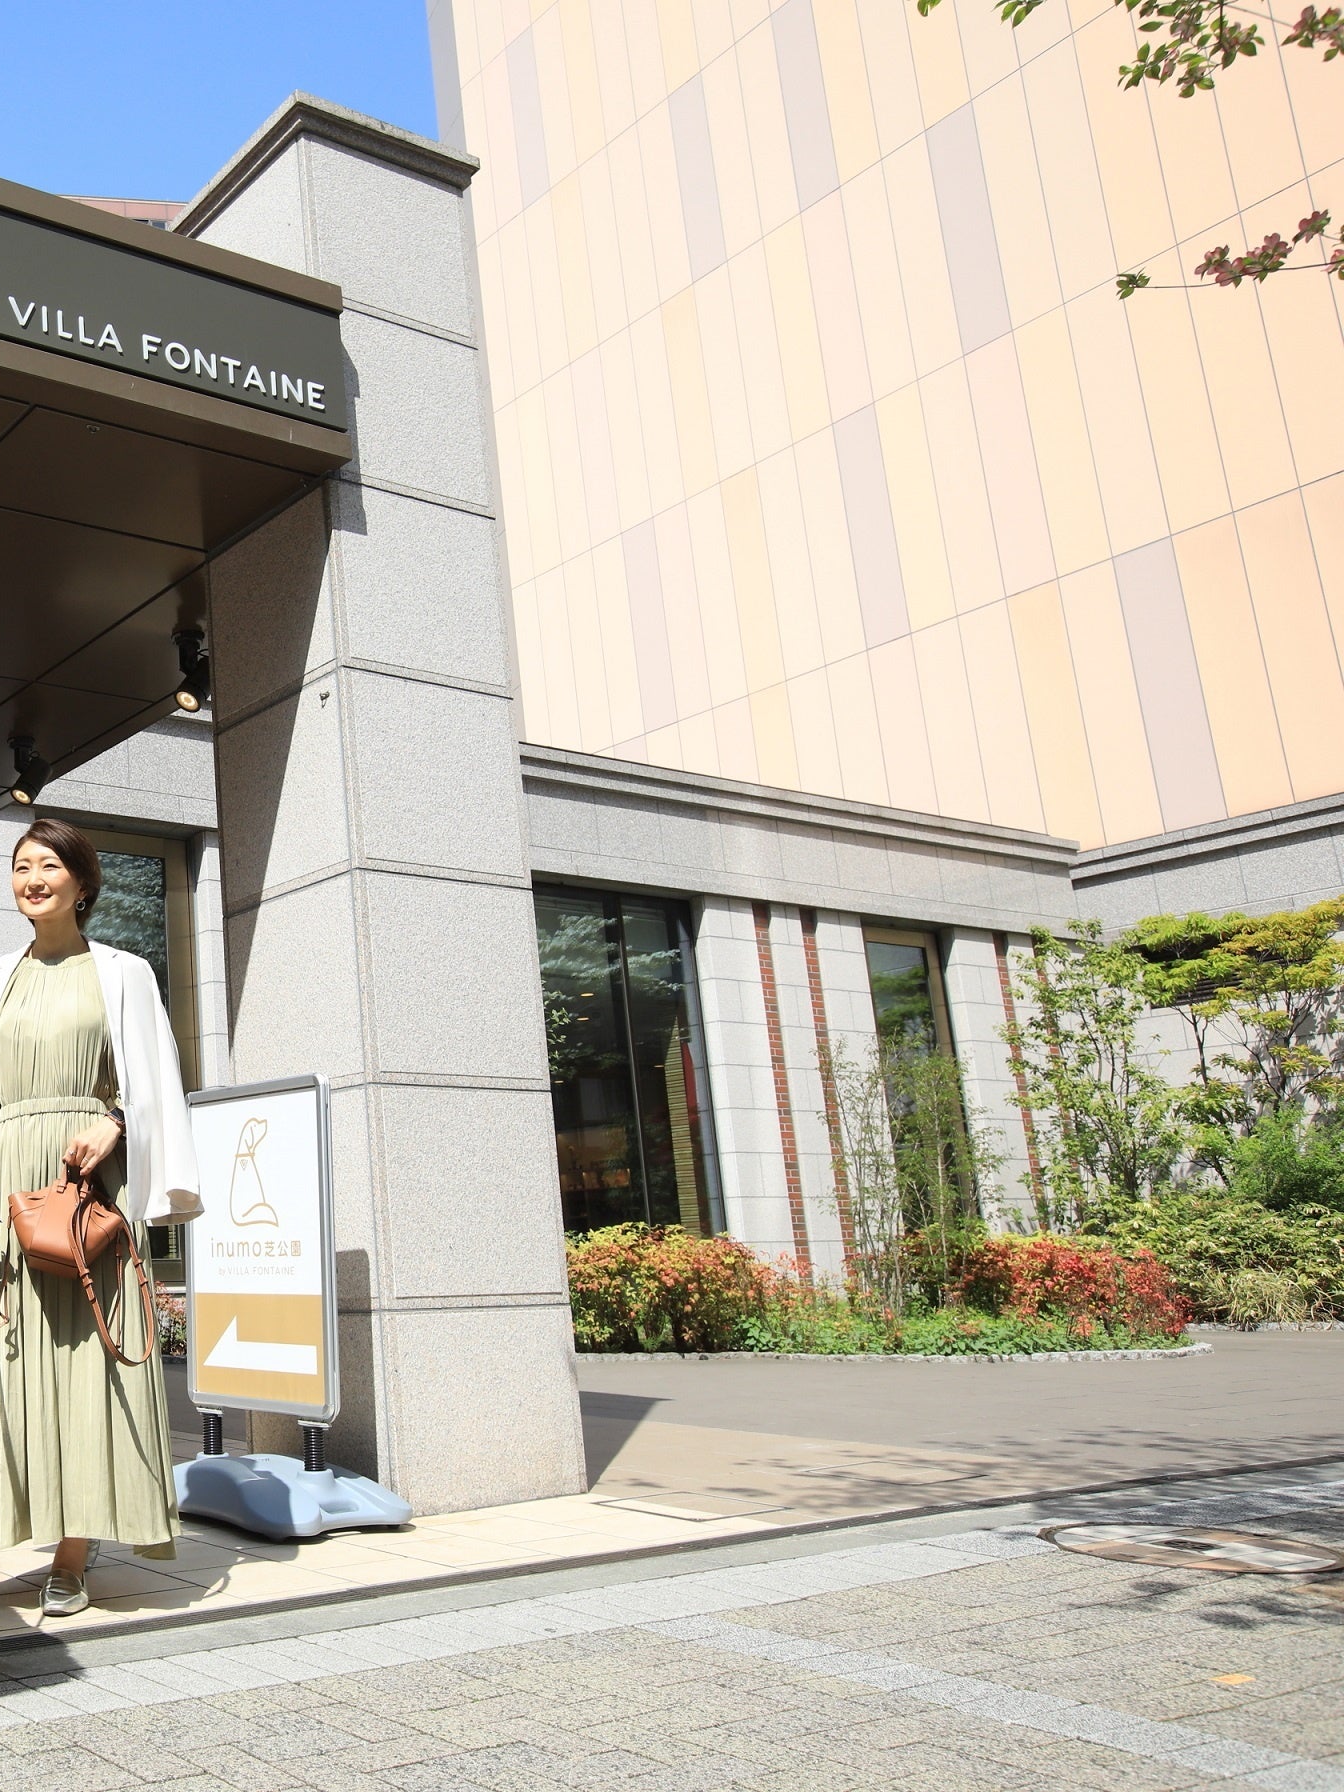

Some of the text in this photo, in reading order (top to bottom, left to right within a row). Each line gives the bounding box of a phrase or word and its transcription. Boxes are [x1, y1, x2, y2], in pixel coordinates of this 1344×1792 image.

[8, 295, 124, 354] VILLA
[141, 333, 327, 412] FONTAINE
[210, 1237, 302, 1259] inumo芝公園
[227, 1266, 250, 1276] VILLA
[252, 1266, 296, 1276] FONTAINE
